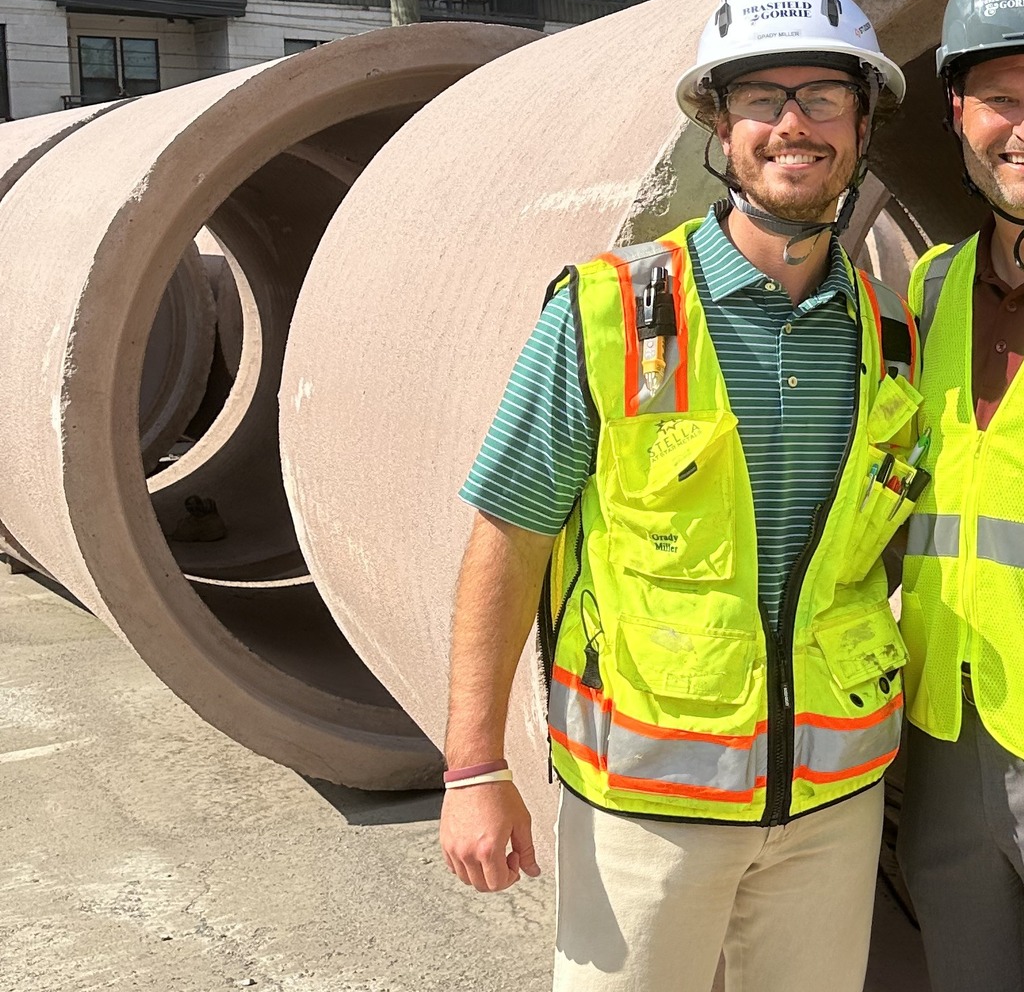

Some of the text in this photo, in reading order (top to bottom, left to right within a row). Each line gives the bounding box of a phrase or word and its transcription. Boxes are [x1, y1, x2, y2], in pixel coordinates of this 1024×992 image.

[743, 1, 812, 15] BRASFIELD
[761, 8, 812, 20] GORRIE
[757, 32, 777, 40] GRADY
[647, 423, 700, 457] STELLA
[652, 533, 679, 543] Grady
[654, 542, 679, 553] Miller
